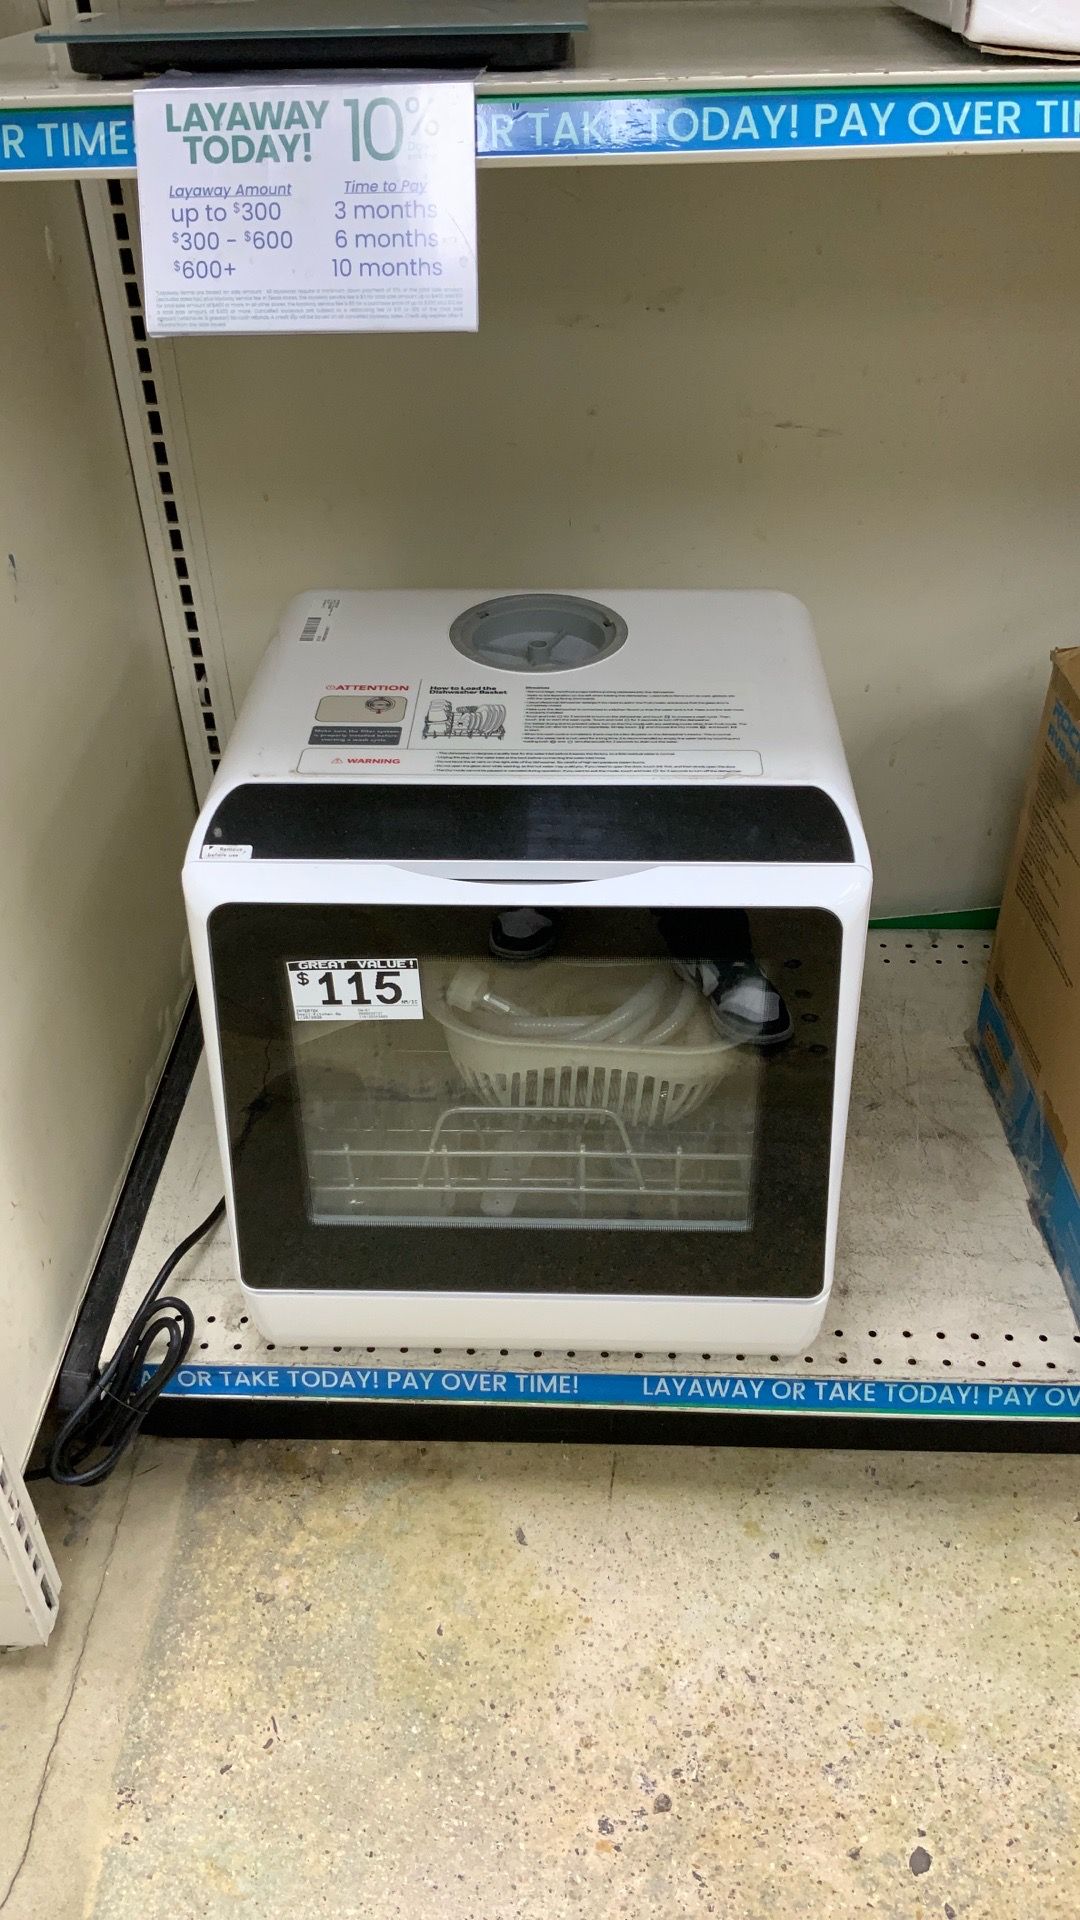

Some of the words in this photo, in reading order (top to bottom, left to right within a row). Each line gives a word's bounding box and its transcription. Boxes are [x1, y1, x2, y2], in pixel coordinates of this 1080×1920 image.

[166, 100, 330, 132] LAYAWAY
[642, 103, 798, 142] TODAY!
[814, 102, 896, 138] PAY
[907, 101, 1021, 136] OVER
[343, 97, 440, 162] 10%
[183, 132, 312, 164] TODAY!
[169, 185, 231, 200] Layaway
[235, 183, 292, 197] Amount
[344, 180, 379, 194] Time
[383, 181, 397, 192] to
[401, 180, 428, 195] Pay
[171, 207, 199, 228] up
[205, 204, 227, 222] to
[233, 201, 281, 221] $300
[334, 200, 347, 220] 3
[353, 200, 438, 219] months
[172, 231, 220, 251] $300
[244, 230, 293, 250] $600
[335, 229, 348, 249] 6
[355, 229, 439, 248] months
[173, 259, 236, 279] $600+
[331, 258, 352, 277] 10
[359, 258, 443, 277] months
[336, 684, 409, 692] ATTENTION
[298, 961, 348, 970] GREAT
[357, 960, 414, 969] VALUE!
[177, 1370, 212, 1388] OR
[219, 1370, 280, 1388] TAKE
[286, 1370, 379, 1389] TODAY!
[387, 1371, 434, 1390] PAY
[441, 1373, 507, 1392] OVER
[513, 1374, 579, 1394] TIME!
[643, 1377, 764, 1400] LAYAWAY
[771, 1380, 806, 1401] OR
[814, 1381, 875, 1402] TAKE
[885, 1383, 979, 1405] TODAY!
[988, 1386, 1038, 1406] PAY
